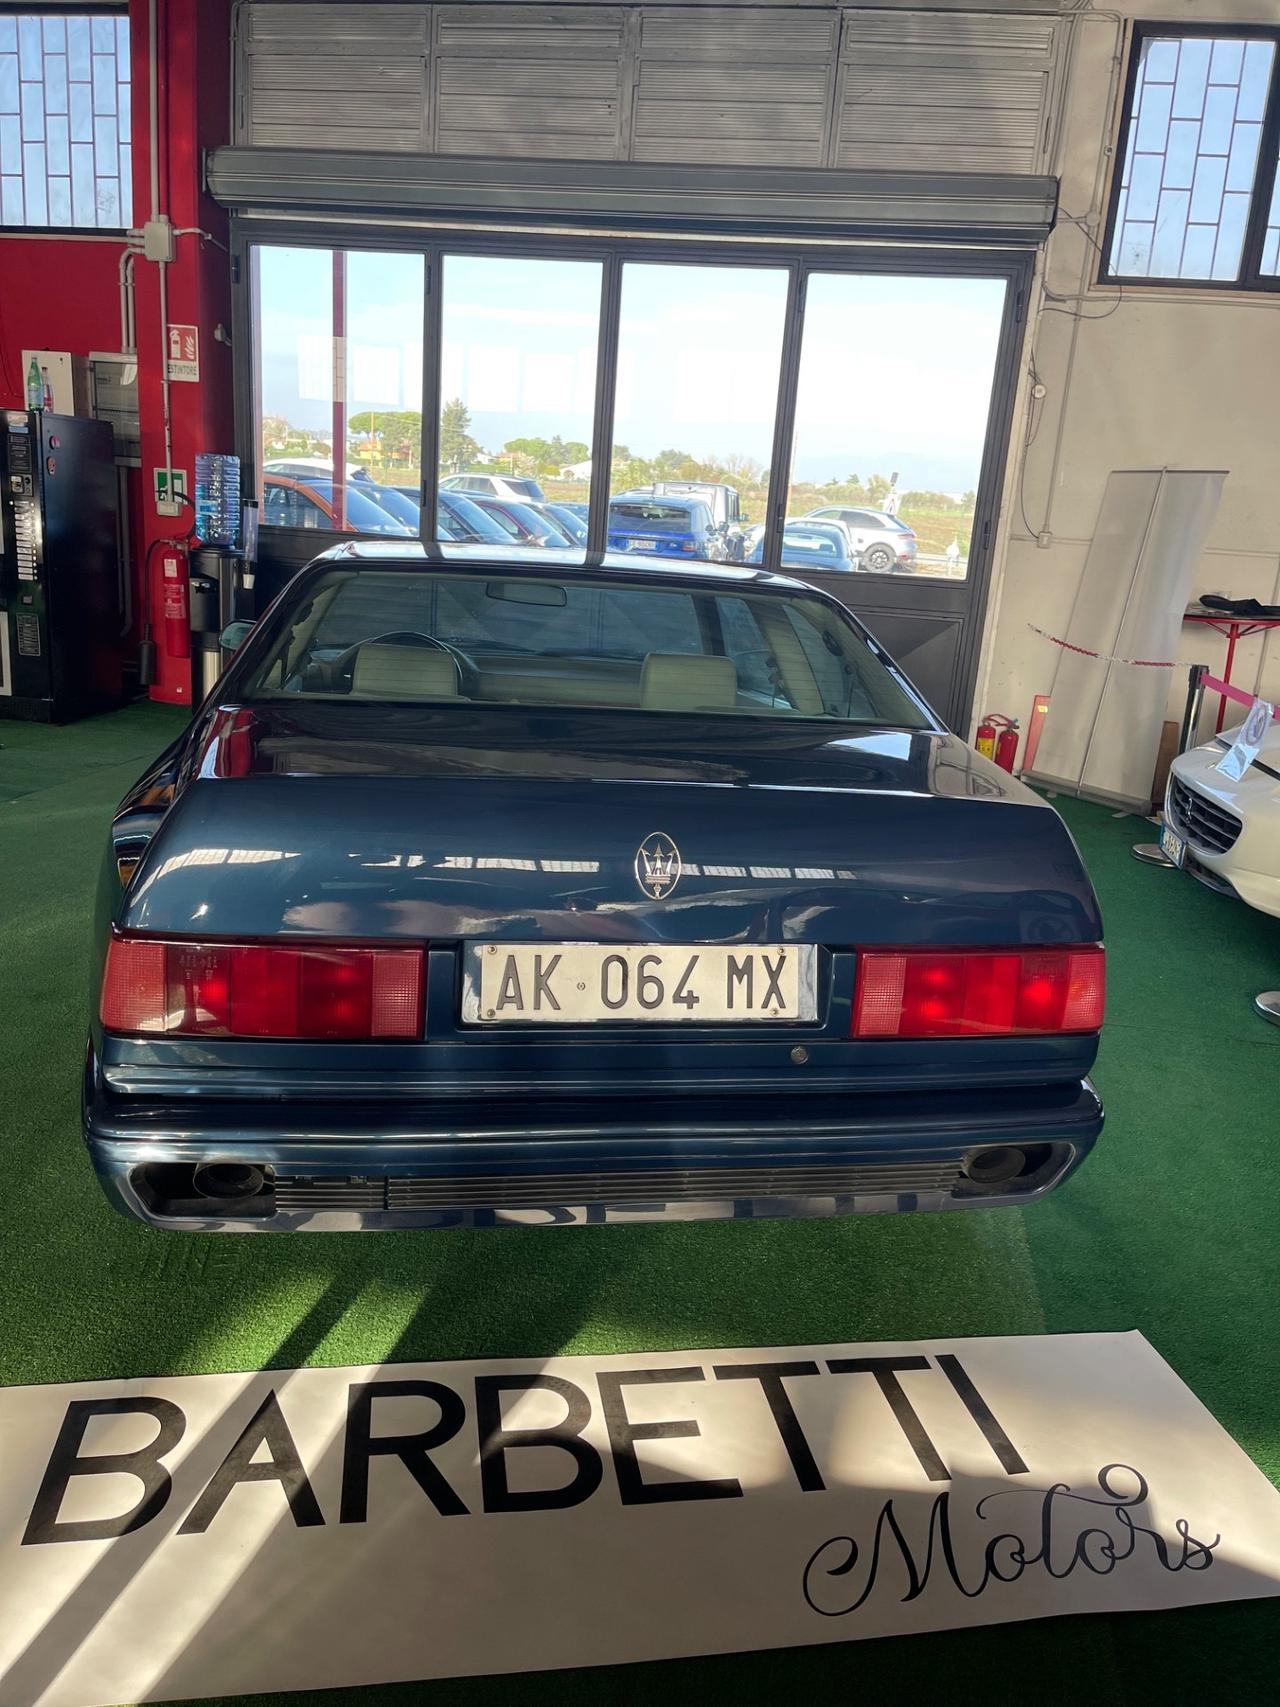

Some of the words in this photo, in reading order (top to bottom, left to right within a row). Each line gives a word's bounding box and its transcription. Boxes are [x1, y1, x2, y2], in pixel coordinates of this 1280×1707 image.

[496, 954, 563, 1010] AK
[600, 954, 700, 1010] 064
[726, 954, 787, 1009] MX
[20, 1354, 1030, 1547] BARBETTI
[802, 1462, 1222, 1617] Motors
